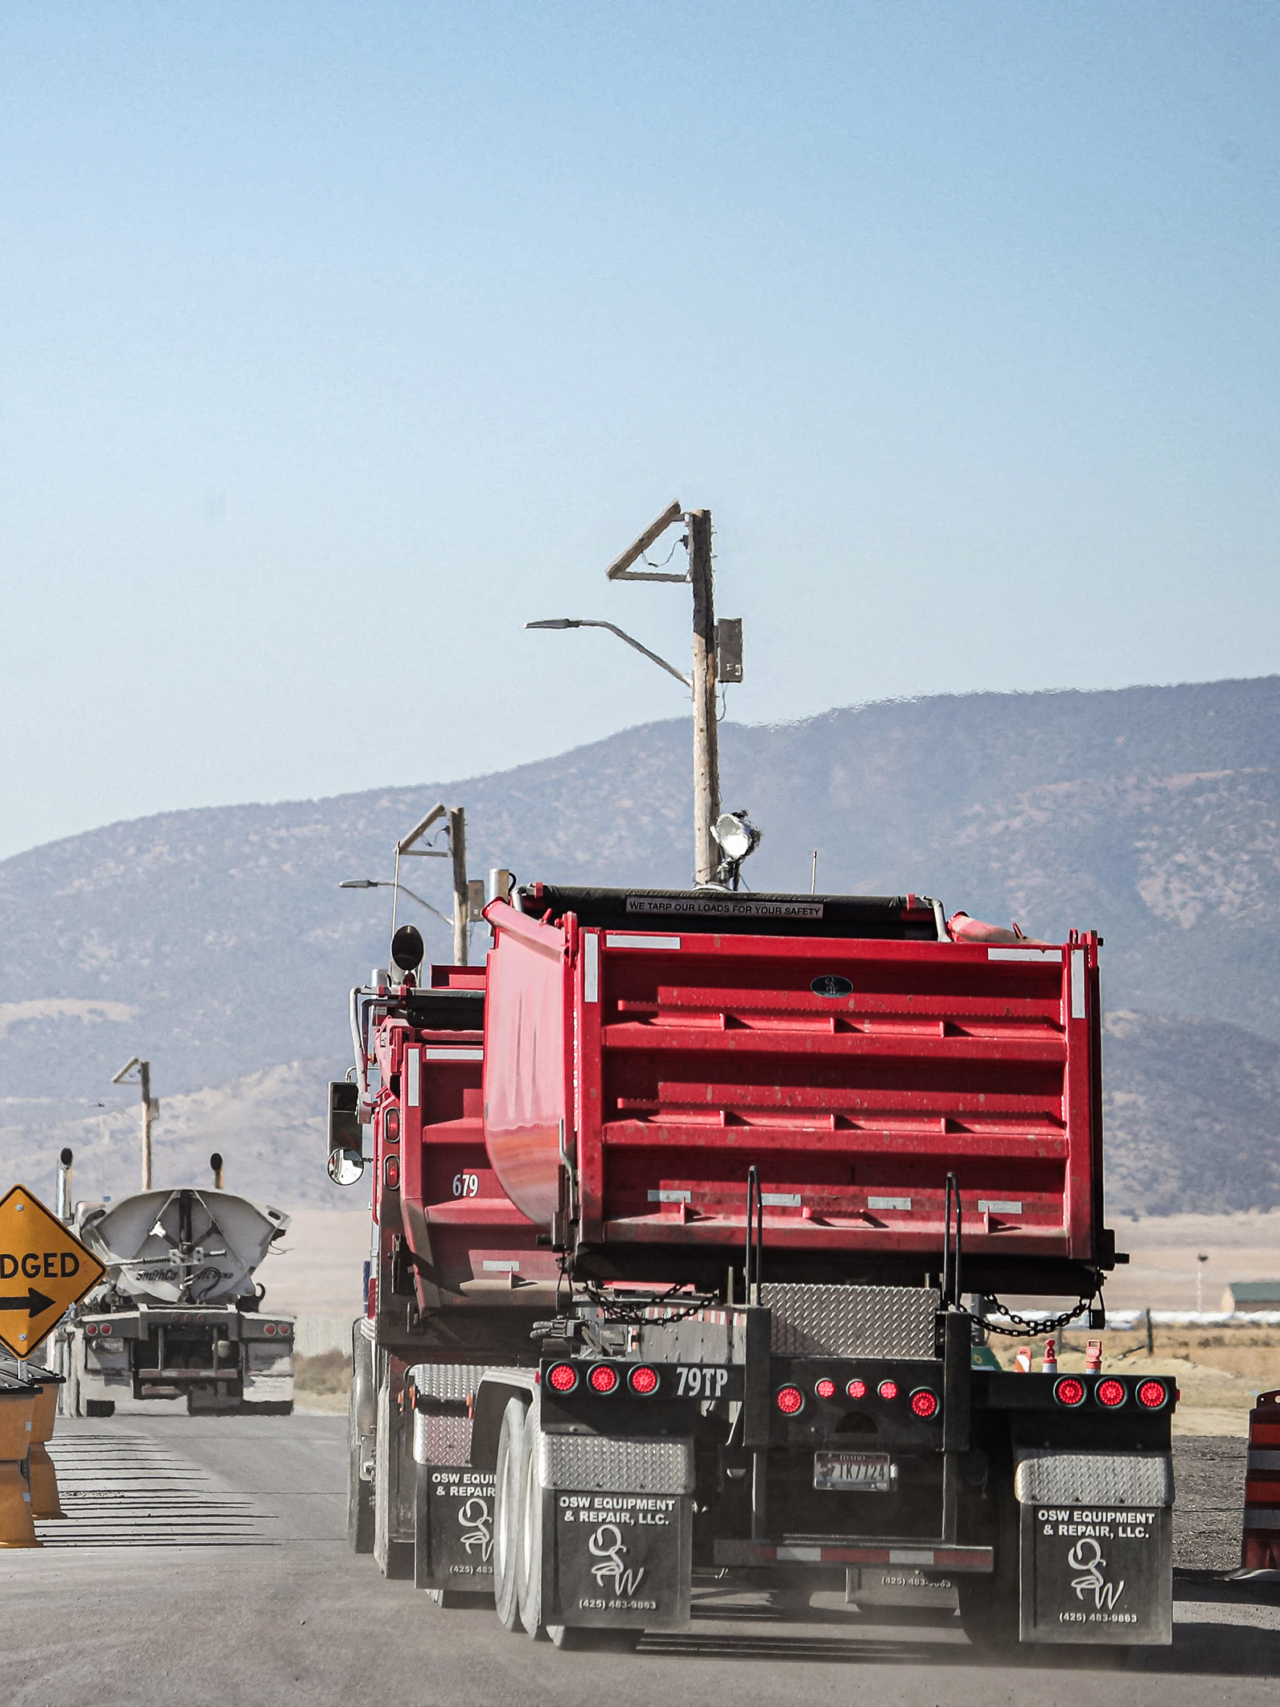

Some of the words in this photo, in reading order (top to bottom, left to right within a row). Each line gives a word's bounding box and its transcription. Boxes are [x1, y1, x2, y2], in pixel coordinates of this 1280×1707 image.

[629, 901, 645, 910] WE
[647, 902, 672, 911] TARP
[674, 903, 695, 912] OUR
[698, 904, 730, 913] LOADS
[732, 905, 752, 914] FOR
[755, 905, 782, 915] YOUR
[784, 906, 821, 916] SAFETY
[453, 1174, 479, 1197] 679
[676, 1366, 728, 1397] 79TP
[840, 1454, 866, 1462] IDAHO
[432, 1473, 460, 1483] OSW
[463, 1473, 497, 1485] EQUI
[436, 1485, 446, 1496] &
[560, 1496, 591, 1508] OSW
[594, 1497, 676, 1511] EQUIPMENT
[564, 1510, 575, 1522] &
[579, 1511, 634, 1526] REPAIR,
[638, 1513, 669, 1525] LLC.
[1038, 1510, 1069, 1521] OSW
[1073, 1511, 1155, 1524] EQUIPMENT
[1043, 1524, 1054, 1536] &
[1058, 1525, 1114, 1540] REPAIR,
[1118, 1526, 1150, 1538] LLC.
[449, 1565, 474, 1575] (425)
[579, 1599, 606, 1610] (425)
[1059, 1612, 1086, 1623] (425)
